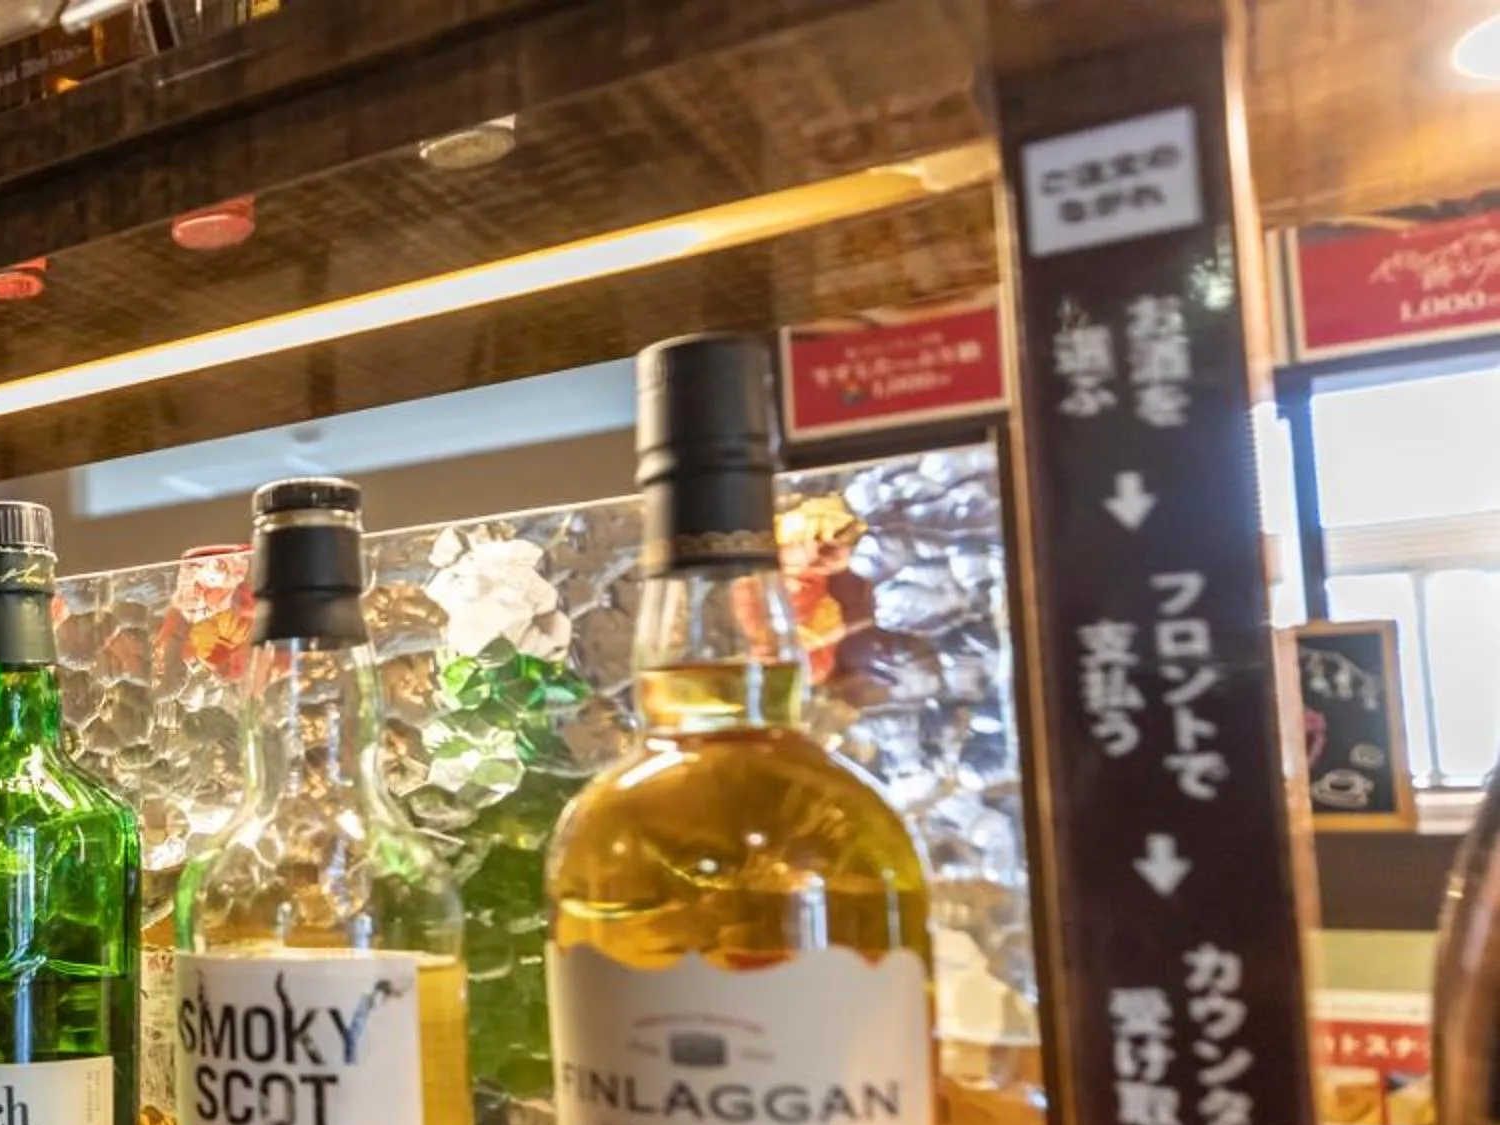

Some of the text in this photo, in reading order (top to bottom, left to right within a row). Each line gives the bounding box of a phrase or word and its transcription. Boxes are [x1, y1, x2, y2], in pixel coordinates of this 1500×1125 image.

[1078, 621, 1146, 757] 支払う
[1150, 572, 1231, 800] フロントで
[179, 990, 371, 1066] SMOKY
